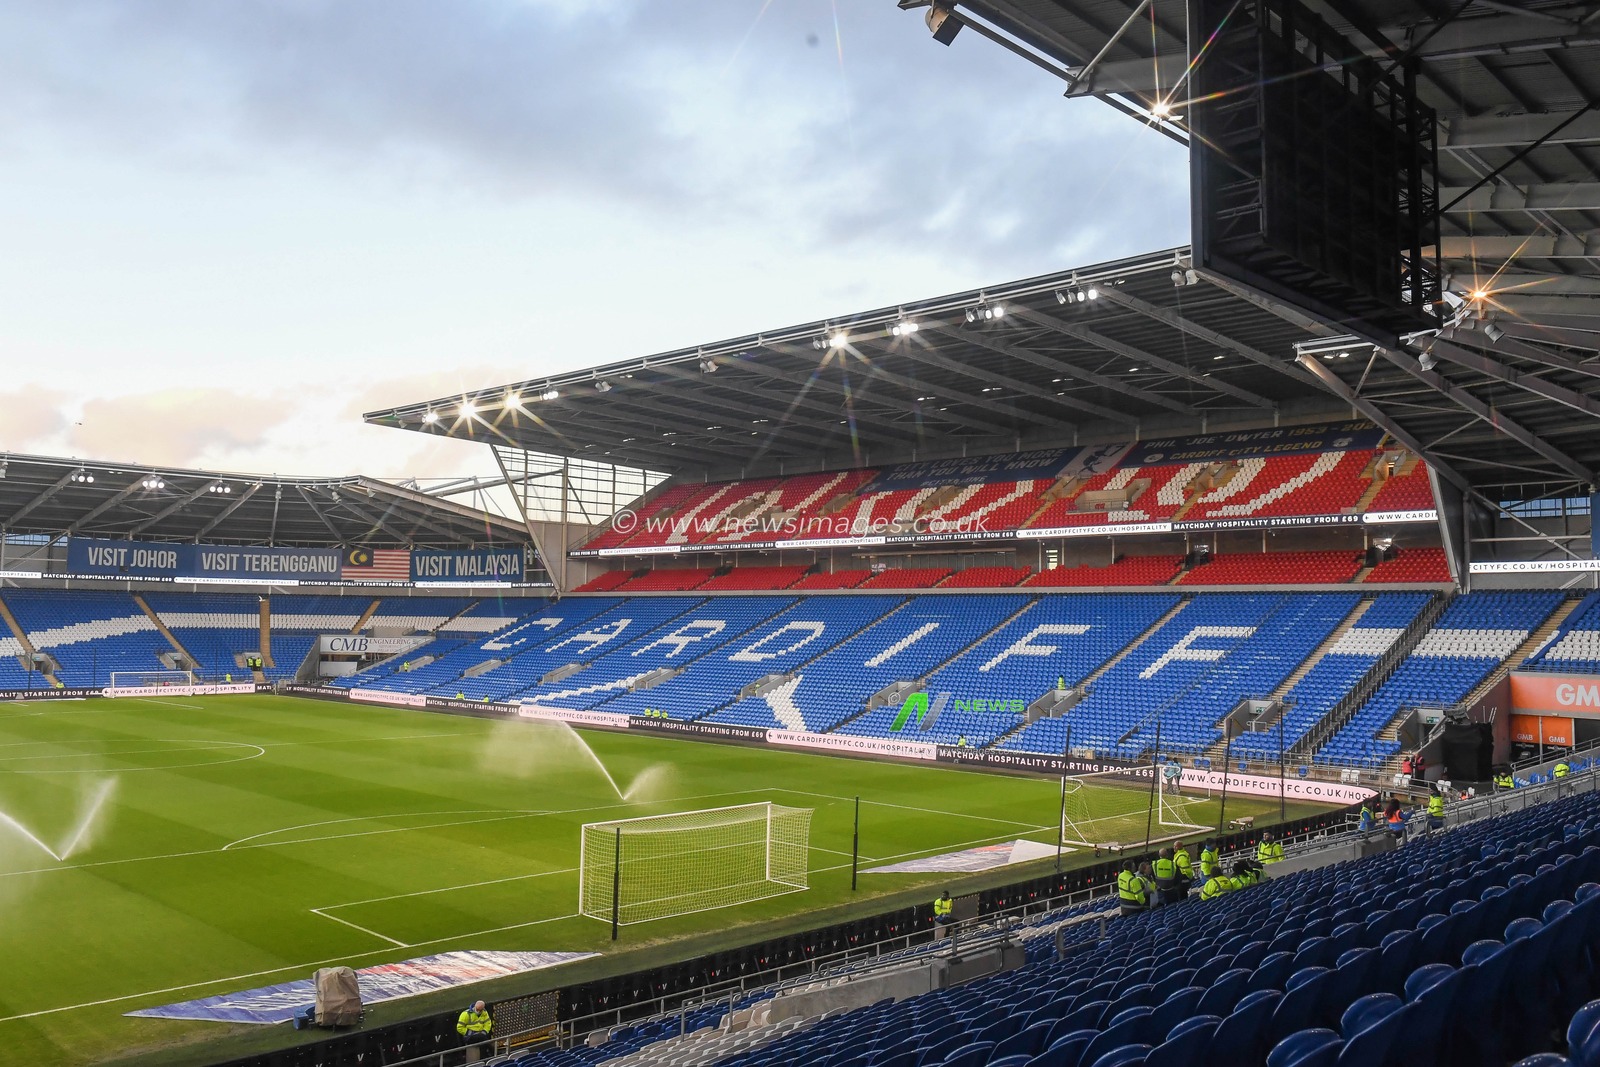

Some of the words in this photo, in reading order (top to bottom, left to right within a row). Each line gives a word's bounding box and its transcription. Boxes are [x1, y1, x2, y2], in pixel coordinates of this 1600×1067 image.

[1144, 440, 1176, 450] PHIL
[1225, 430, 1283, 442] DWYER
[930, 456, 979, 468] LOVES
[985, 454, 1015, 464] YOU
[1019, 448, 1067, 460] MORE
[1170, 450, 1225, 460] CARDIFF
[1228, 446, 1260, 456] CITY
[1264, 441, 1322, 453] LEGEND
[886, 469, 926, 481] THAN
[928, 466, 958, 477] YOU
[960, 463, 998, 474] WILL
[1004, 458, 1056, 470] KNOW
[1216, 519, 1268, 528] HOSPITALITY
[1271, 517, 1312, 526] STARTING
[1314, 516, 1338, 524] FROM
[88, 547, 128, 567] VISIT
[130, 549, 177, 569] JOHOR
[202, 552, 239, 571] VISIT
[243, 554, 338, 573] TERENGGANU
[416, 556, 452, 576] VISIT
[456, 554, 520, 576] MALAYSIA
[330, 638, 368, 652] CMB
[631, 720, 660, 728] MATCHDAY
[662, 721, 699, 732] HOSPITALITY
[700, 726, 730, 735] STARTING
[988, 754, 1048, 768] HOSPITALITY
[1136, 769, 1154, 778] £69
